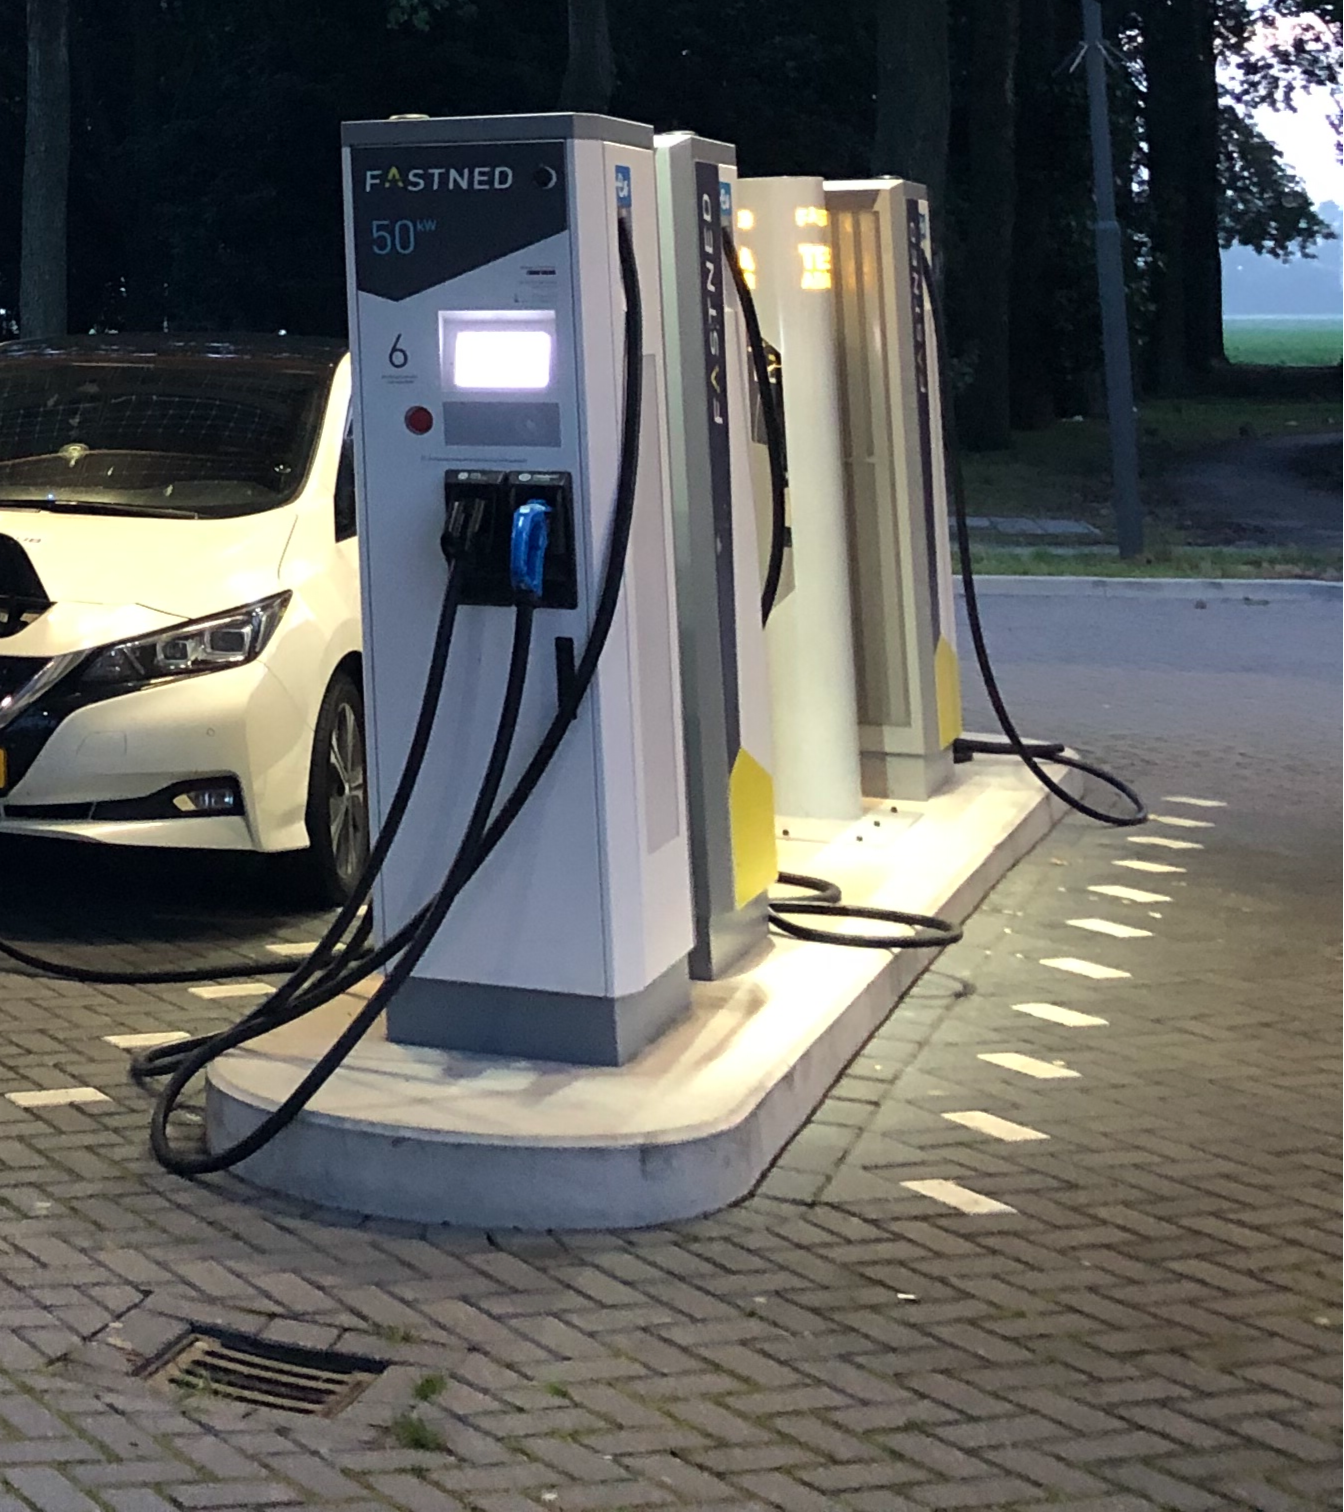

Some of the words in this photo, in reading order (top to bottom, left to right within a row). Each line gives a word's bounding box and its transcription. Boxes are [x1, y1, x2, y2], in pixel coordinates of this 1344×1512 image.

[365, 166, 513, 192] FASTNED
[701, 193, 723, 425] FASTNED
[388, 332, 409, 368] 6
